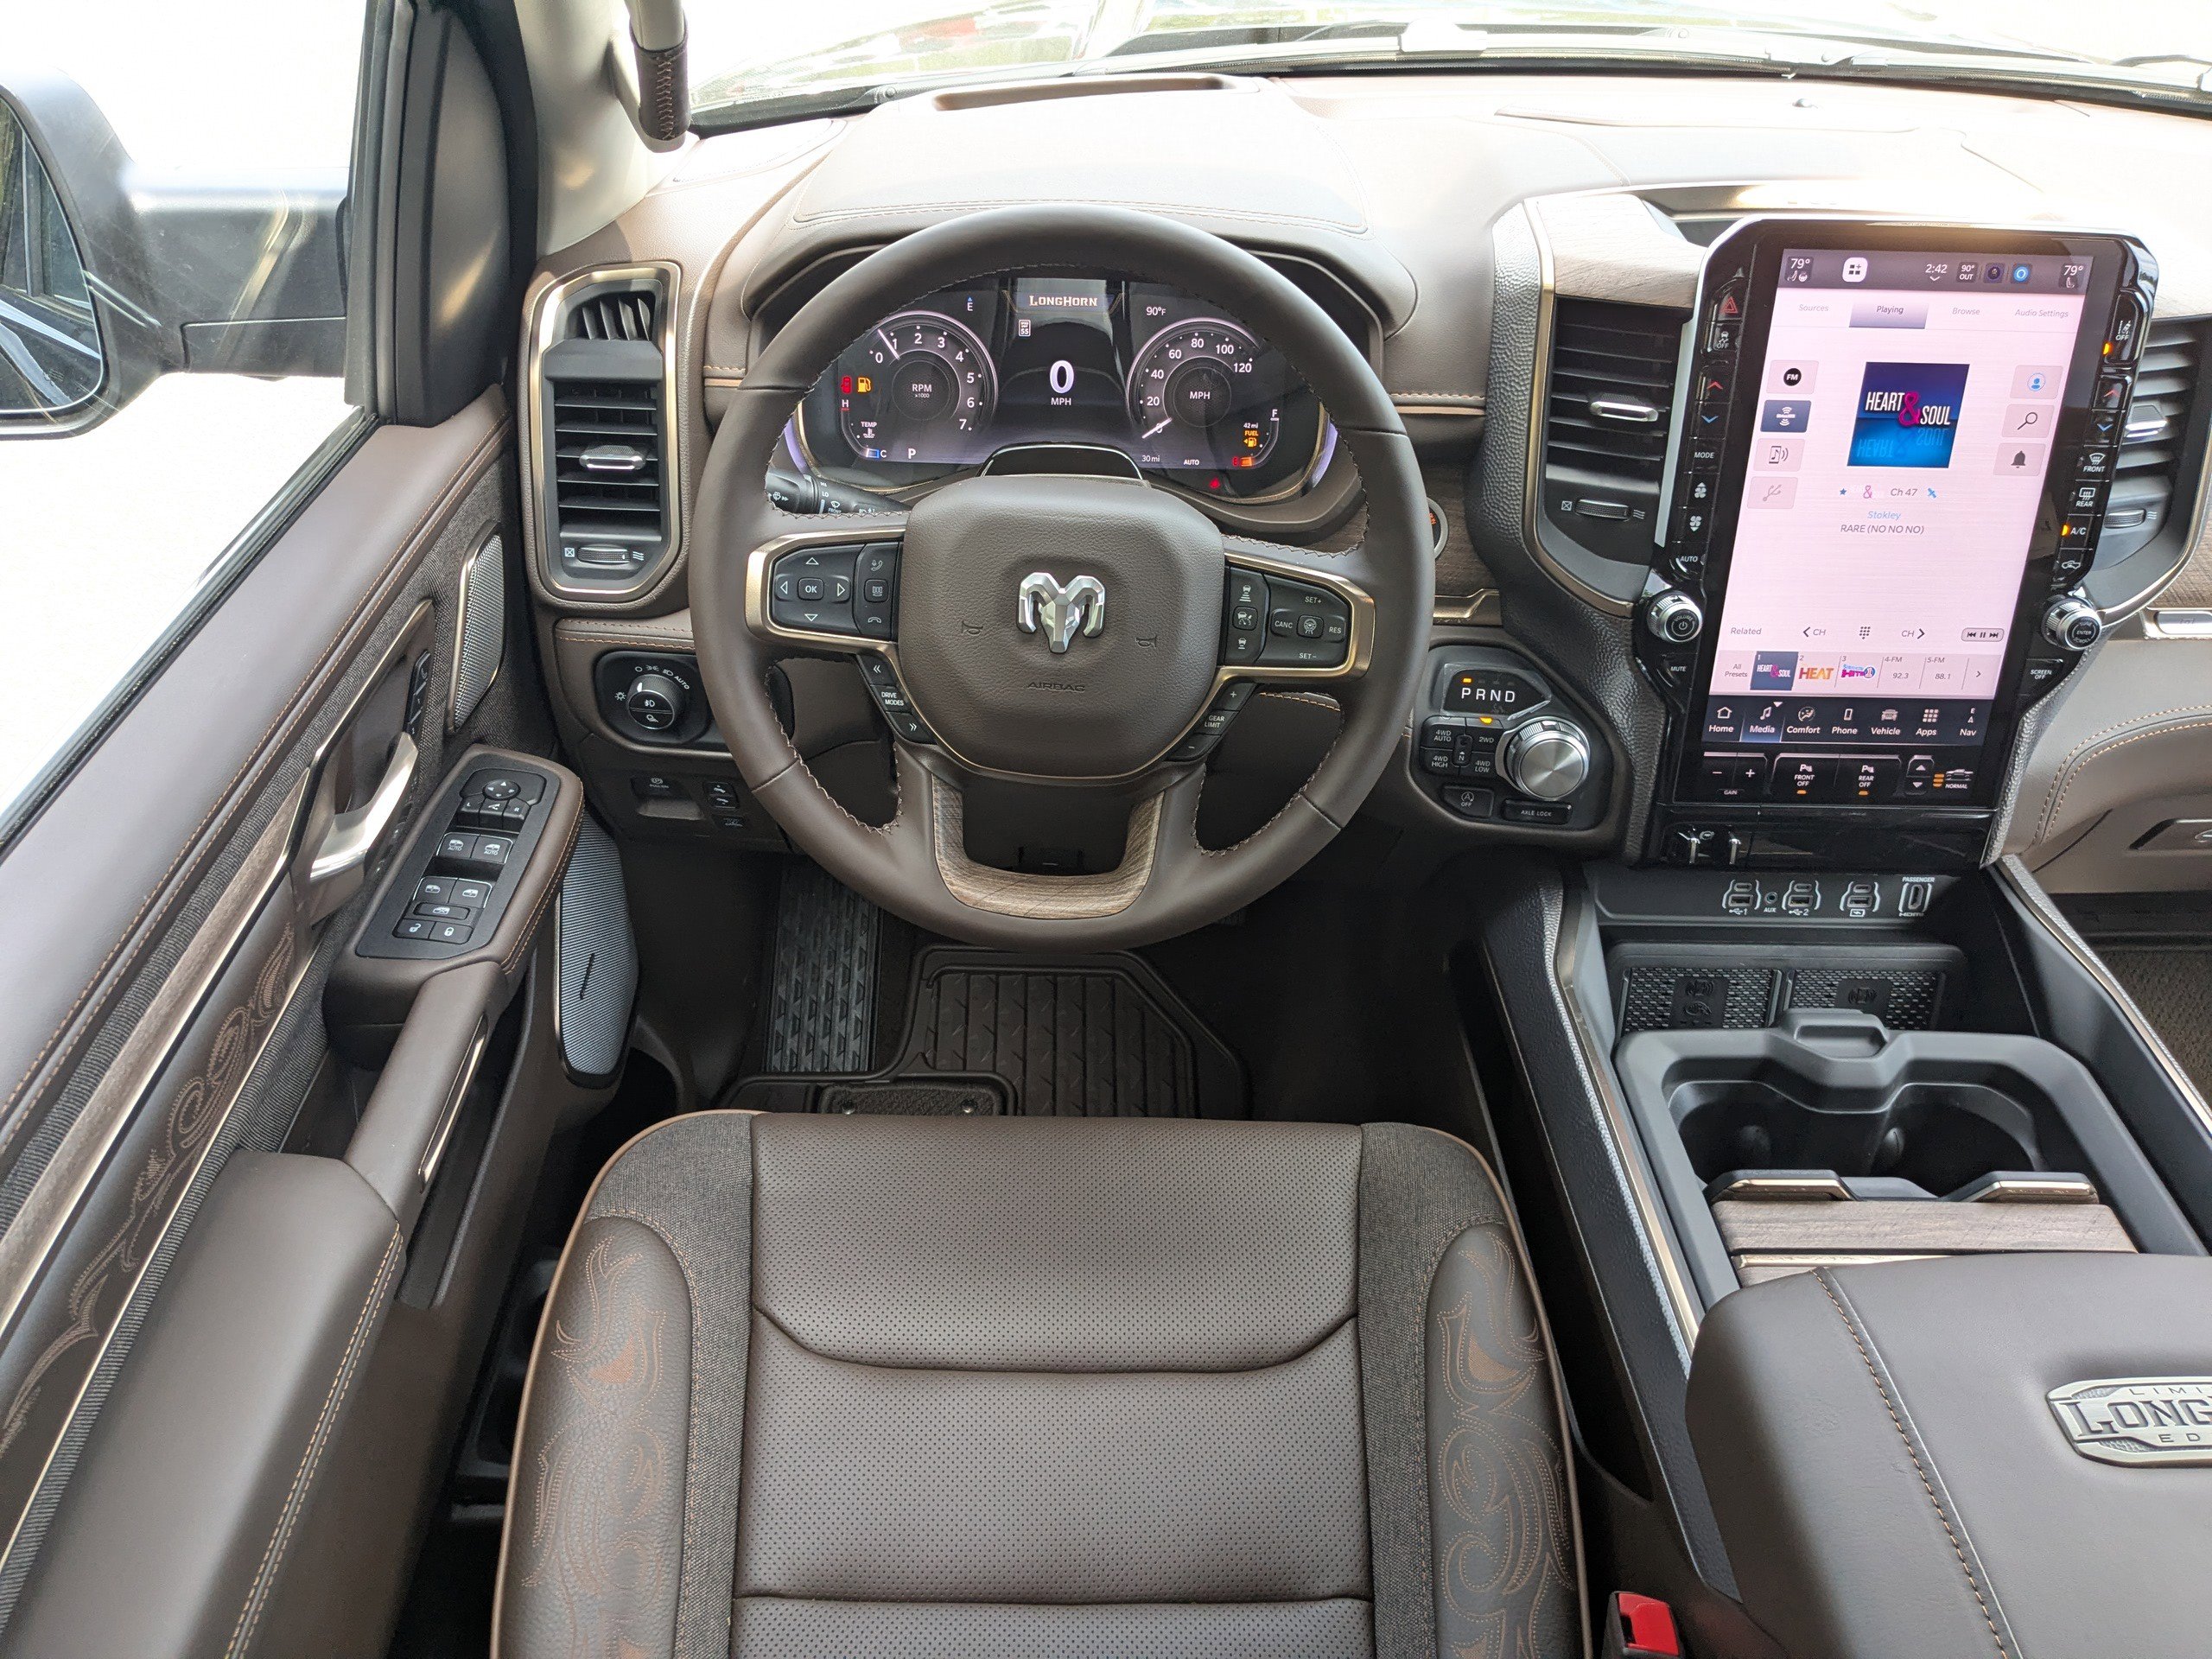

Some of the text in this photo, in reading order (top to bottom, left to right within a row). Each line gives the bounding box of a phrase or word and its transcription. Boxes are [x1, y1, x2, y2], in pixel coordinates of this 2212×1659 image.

[1790, 258, 1811, 270] 79°
[1925, 264, 1948, 274] 2:42
[2063, 265, 2084, 275] 79°
[1029, 296, 1097, 307] LONGHORN
[967, 302, 974, 312] E
[1146, 307, 1166, 316] 90°F
[1799, 303, 1829, 312] Sources
[1876, 305, 1904, 315] Playing
[1952, 307, 1980, 315] Browse
[2015, 308, 2069, 319] Audio Settings
[914, 333, 923, 344] 2
[938, 337, 945, 348] 3
[1191, 338, 1205, 348] 80
[1169, 349, 1182, 359] 60
[1216, 345, 1234, 354] 100
[875, 353, 883, 364] 0
[955, 351, 963, 362] 4
[1233, 363, 1252, 372] 120
[966, 372, 975, 384] 5
[1049, 359, 1074, 394] 0
[1151, 369, 1164, 379] 40
[912, 384, 932, 392] RPM
[1190, 391, 1210, 400] MPH
[842, 399, 849, 408] H
[966, 397, 975, 408] 6
[1147, 397, 1160, 406] 20
[1271, 409, 1278, 417] F
[1865, 391, 1904, 411] HEART
[1920, 406, 1951, 425] SOUL
[959, 419, 967, 430] 7
[908, 448, 917, 459] P
[1890, 488, 1917, 497] Ch 47
[1867, 511, 1901, 520] Stokley
[1840, 524, 1866, 533] RARE
[1867, 524, 1887, 534] (NO
[1905, 525, 1924, 535] NO)
[2070, 527, 2087, 536] A/C
[804, 585, 817, 594] OK
[1274, 620, 1293, 629] CANC
[1731, 626, 1762, 635] Related
[1798, 668, 1834, 680] HEAT
[674, 675, 690, 690] AUTO
[1027, 681, 1085, 693] AIRBAG
[1708, 724, 1734, 733] Home
[1786, 725, 1821, 734] Comfort
[1916, 728, 1937, 737] Apps
[2129, 1386, 2212, 1395] LIMI
[2058, 1395, 2212, 1433] LONG
